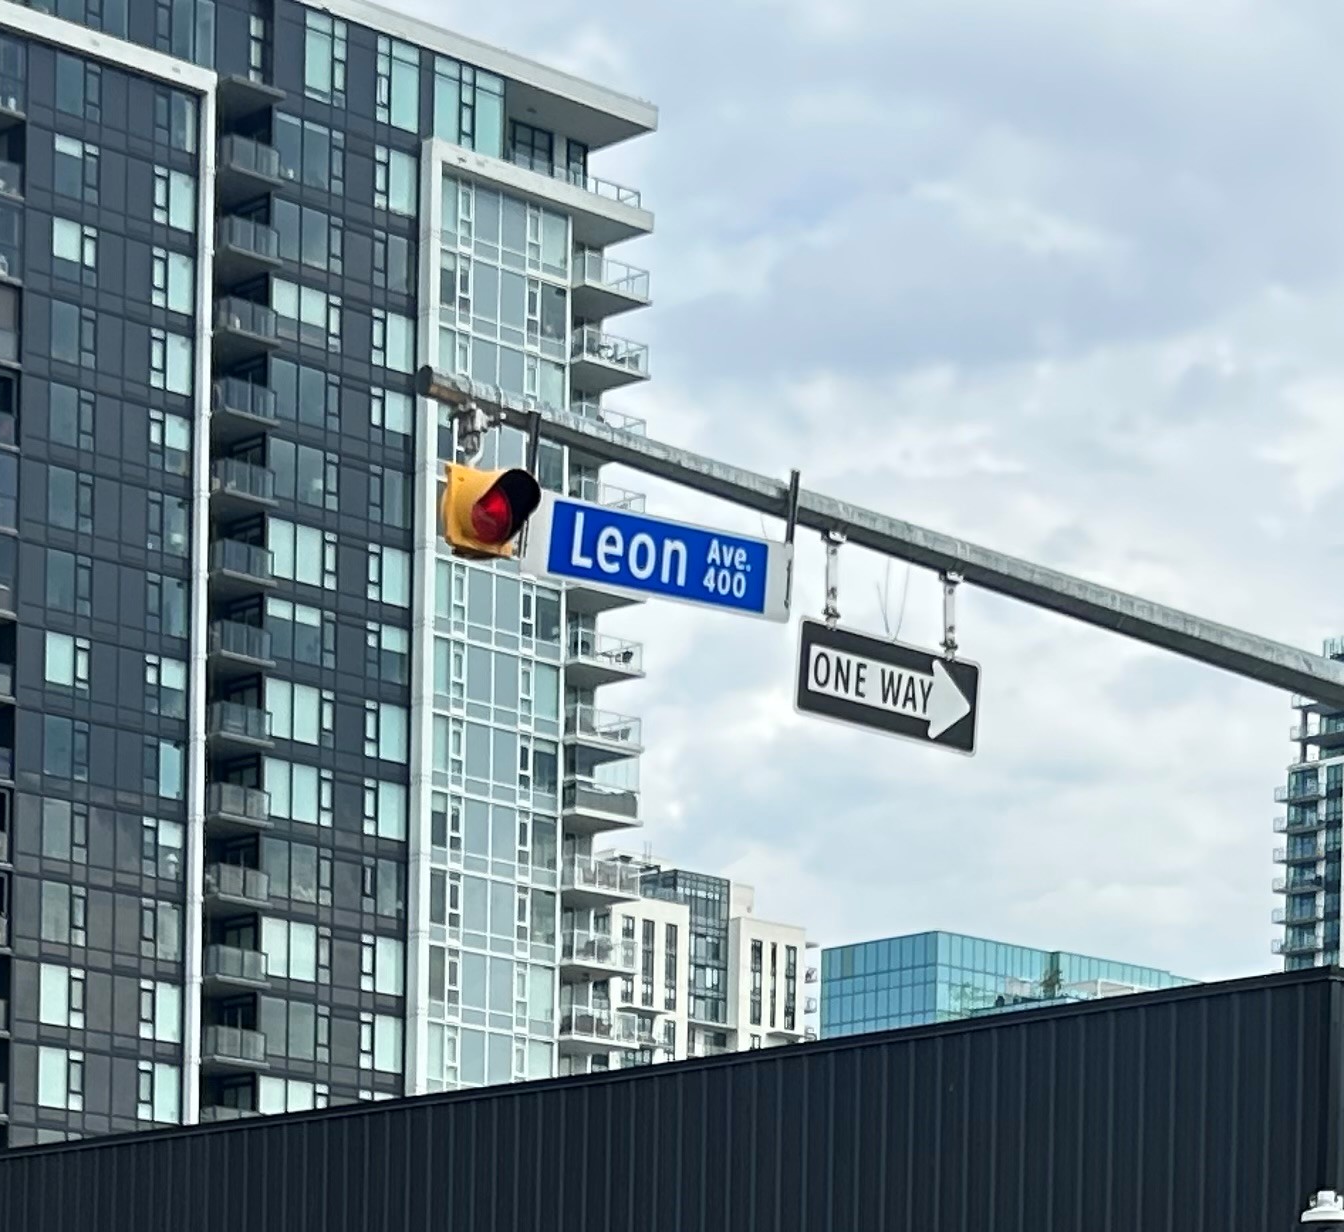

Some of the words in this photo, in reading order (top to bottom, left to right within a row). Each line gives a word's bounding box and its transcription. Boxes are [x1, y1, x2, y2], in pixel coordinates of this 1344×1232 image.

[571, 511, 687, 587] Leon
[707, 537, 752, 572] Ave.
[703, 567, 747, 599] 400
[814, 652, 867, 698] ONE
[881, 668, 933, 715] WAY
